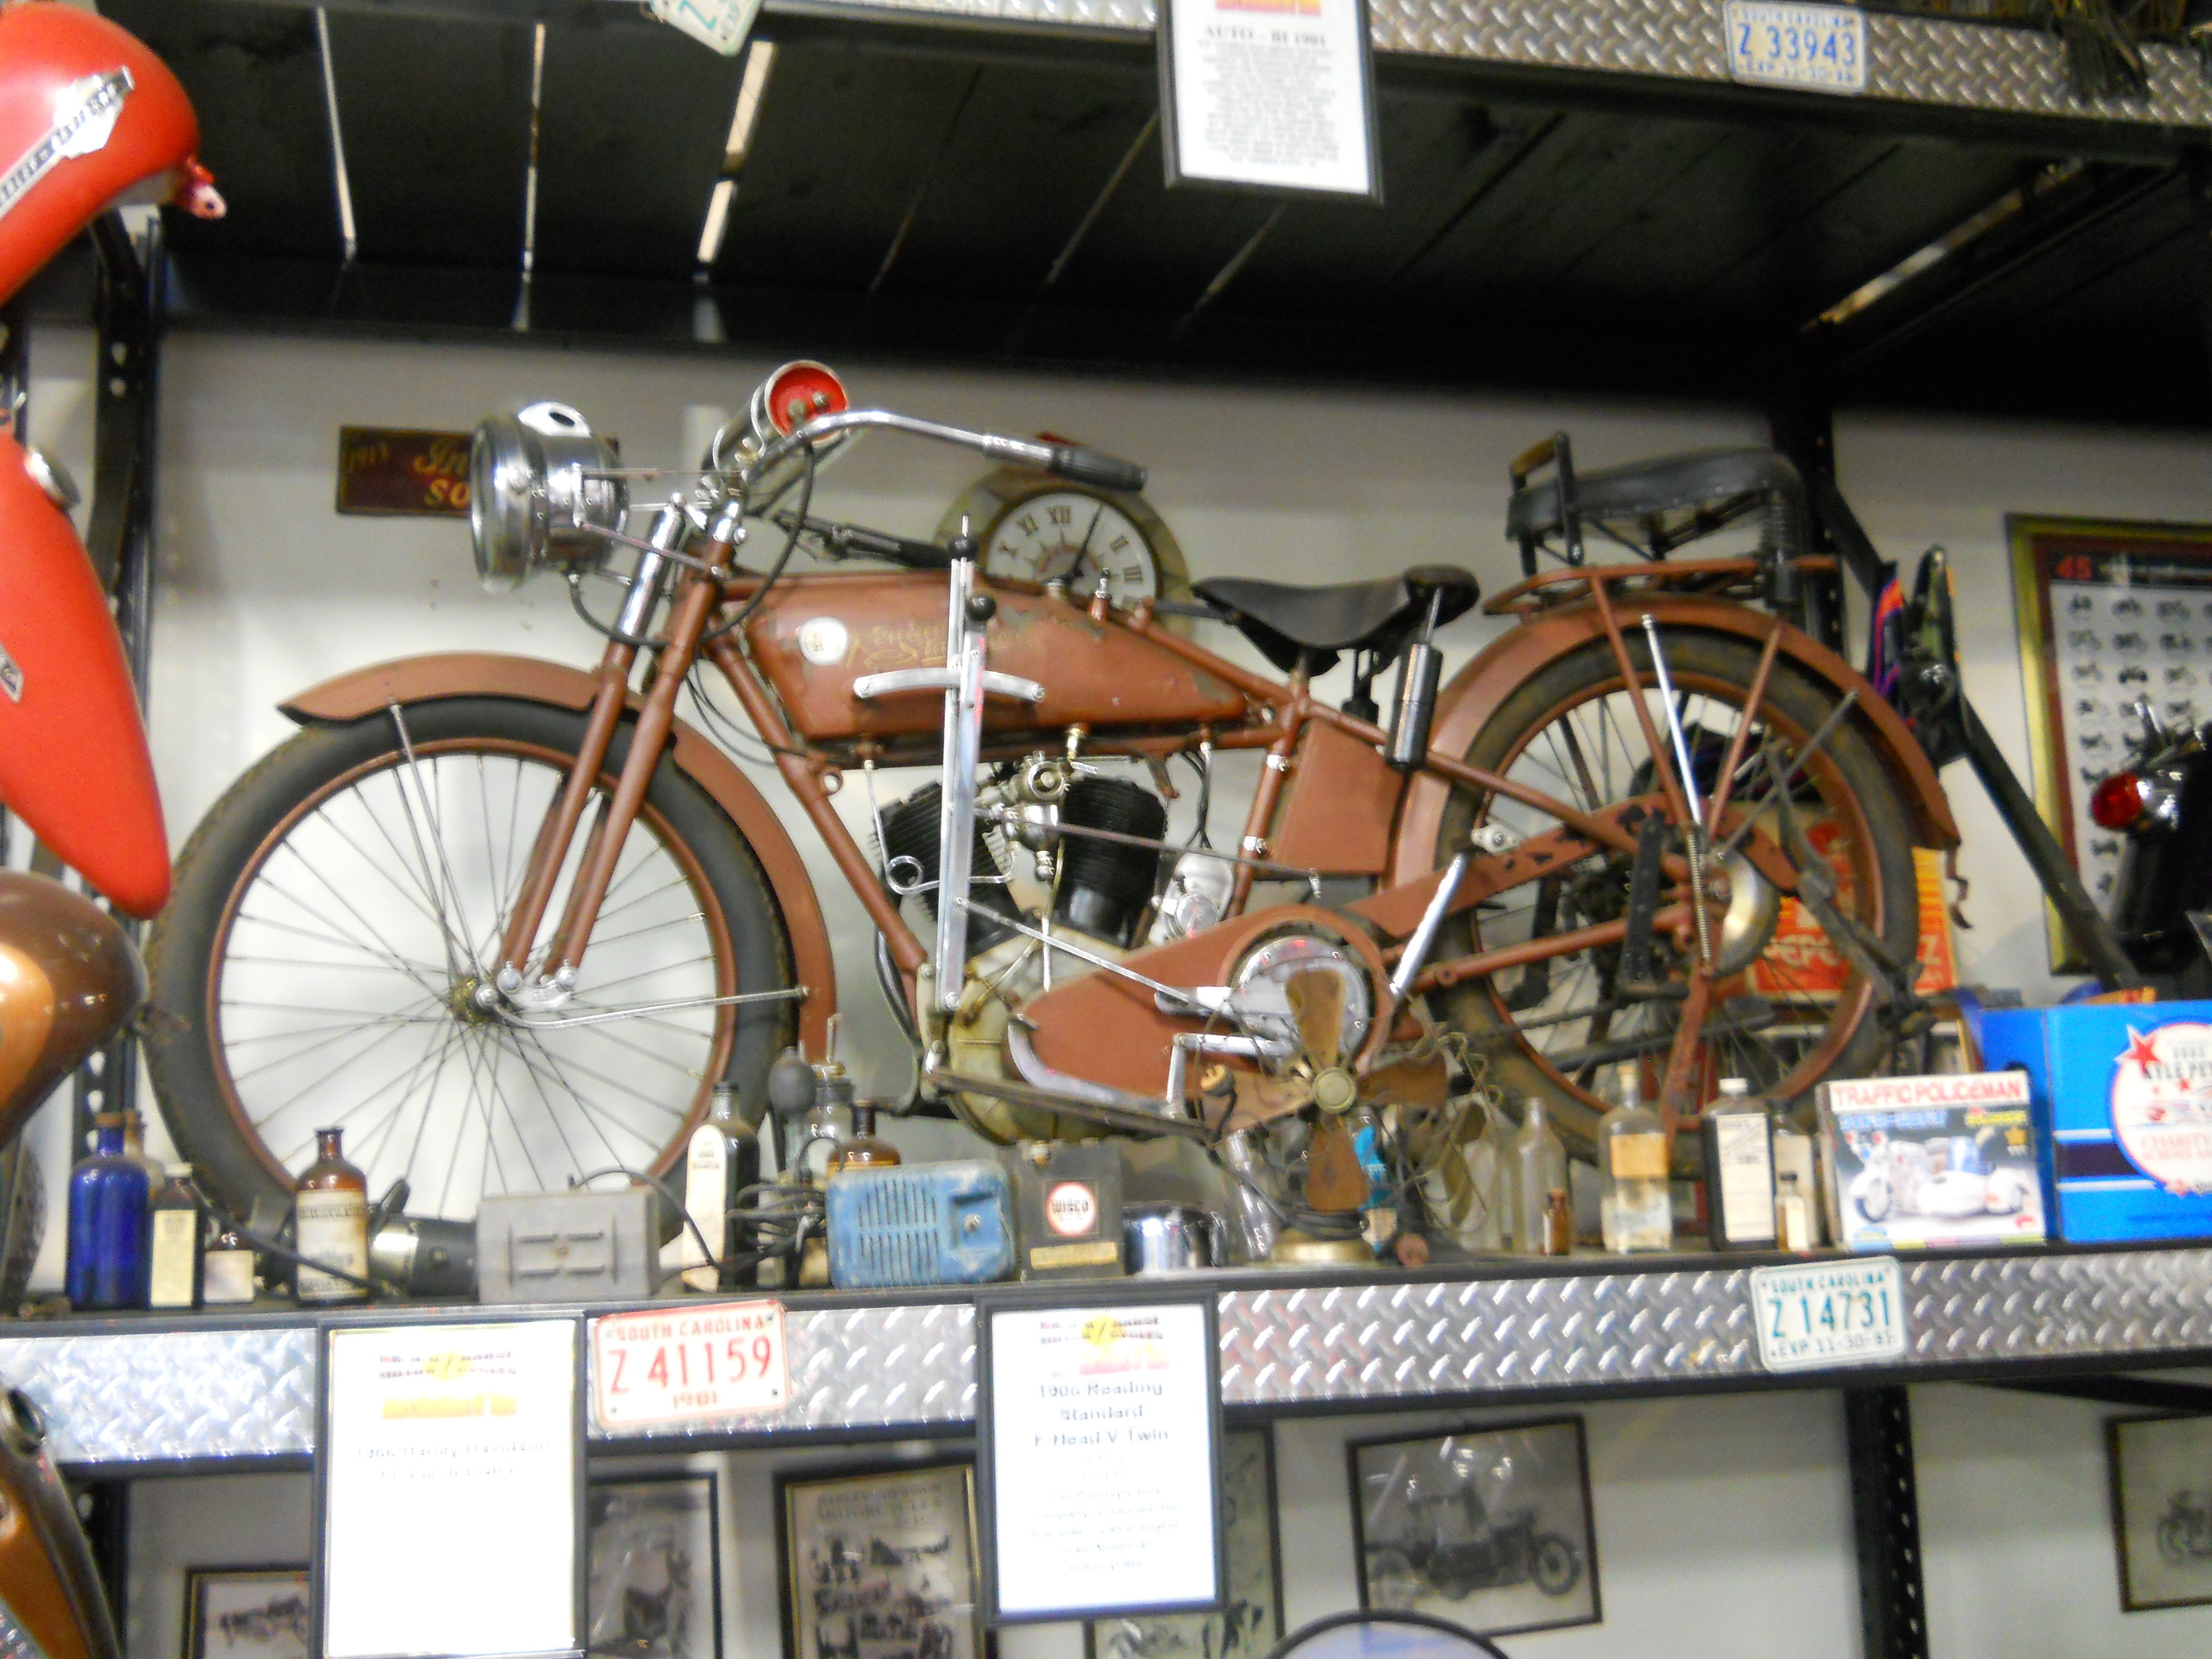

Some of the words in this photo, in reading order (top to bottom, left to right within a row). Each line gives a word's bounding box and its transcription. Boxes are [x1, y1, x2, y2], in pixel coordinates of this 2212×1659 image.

[1204, 25, 1254, 40] AUTO
[1737, 22, 1753, 56] Z
[1765, 24, 1856, 67] 33943
[1833, 1082, 1912, 1107] TRAFFIC
[1915, 1078, 2021, 1103] POLICEMAN
[1770, 1277, 1815, 1293] SOUTH
[1818, 1272, 1884, 1288] CAROLINA
[1767, 1297, 1787, 1339] Z
[1800, 1289, 1889, 1334] 14731
[615, 1325, 673, 1342] SOUTH
[678, 1315, 766, 1337] CAROLINA
[607, 1348, 630, 1395] Z
[647, 1334, 772, 1389] 41159
[1087, 1379, 1164, 1398] Reading
[1060, 1404, 1145, 1423] Standard
[1052, 1432, 1101, 1447] Head
[1107, 1431, 1120, 1444] V
[1127, 1428, 1170, 1443] Twin
